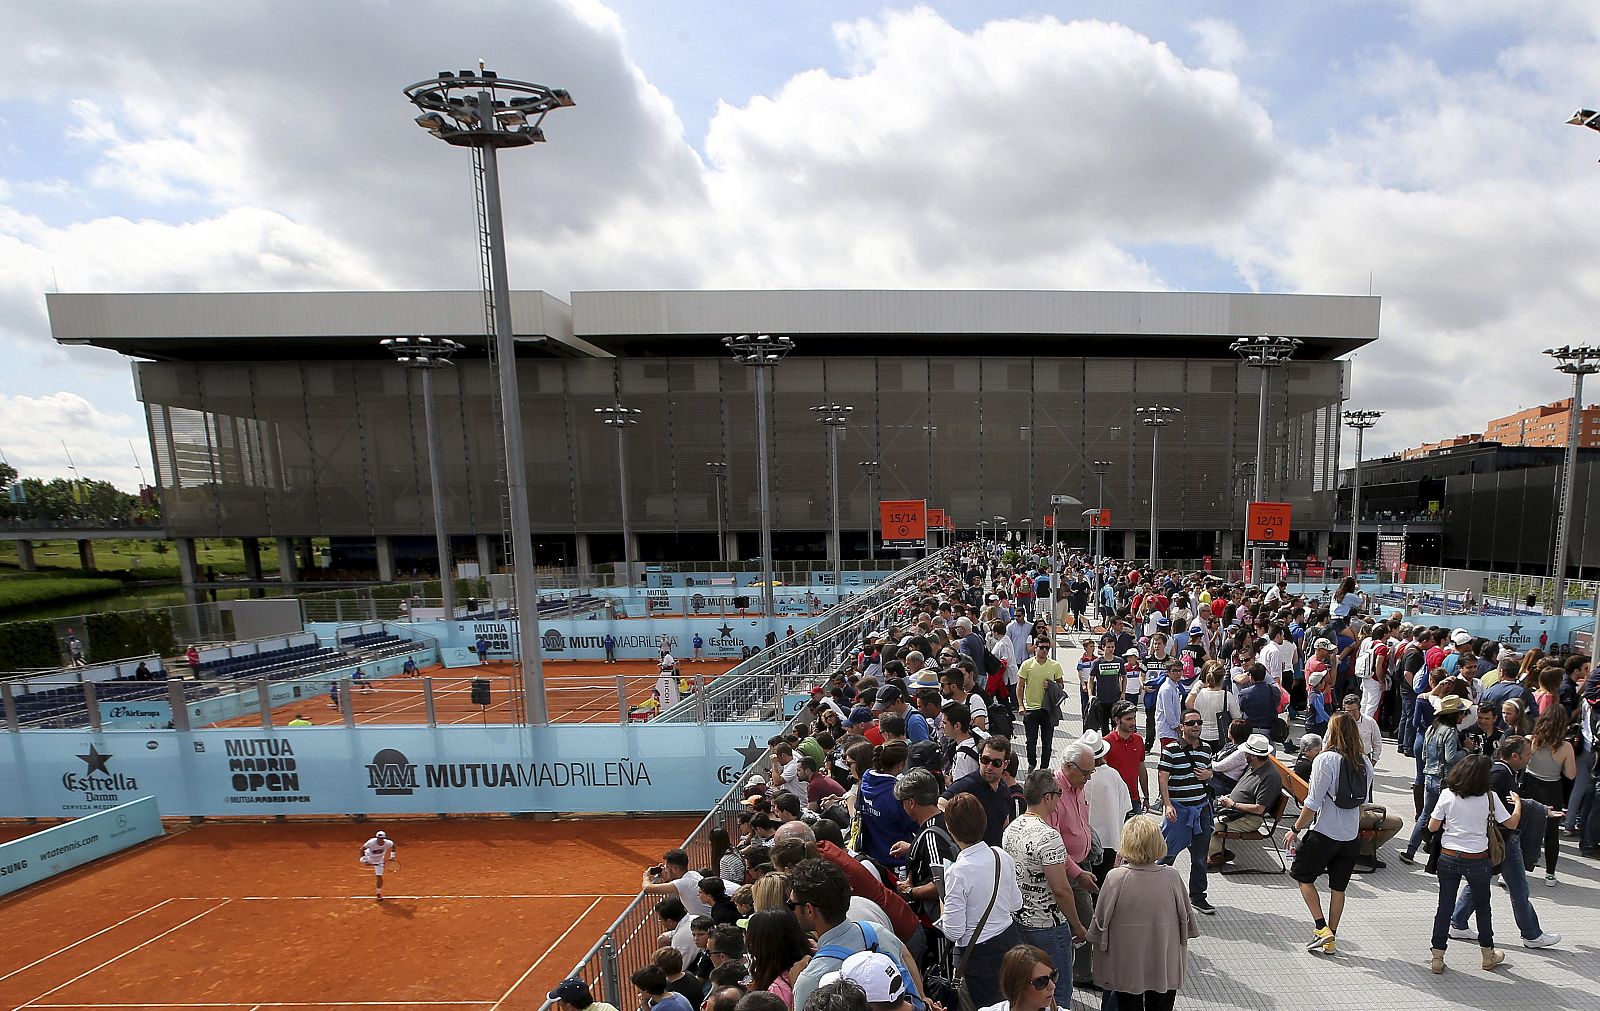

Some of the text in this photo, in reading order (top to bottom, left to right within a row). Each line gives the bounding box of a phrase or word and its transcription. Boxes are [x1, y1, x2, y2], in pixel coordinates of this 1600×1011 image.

[889, 513, 917, 524] 15/14
[1257, 516, 1283, 526] 12/13
[474, 624, 507, 633] MUTUA
[709, 636, 745, 647] Estrella
[1497, 634, 1531, 644] Estrella
[224, 738, 295, 757] MUTUA
[228, 757, 297, 772] MADRID
[424, 757, 652, 788] MUTUAMADRILEÑA
[62, 771, 138, 792] Estrella
[231, 772, 300, 792] OPEN
[85, 791, 119, 803] Damm
[39, 834, 99, 861] wtatennis.com
[0, 859, 28, 877] SUNG
